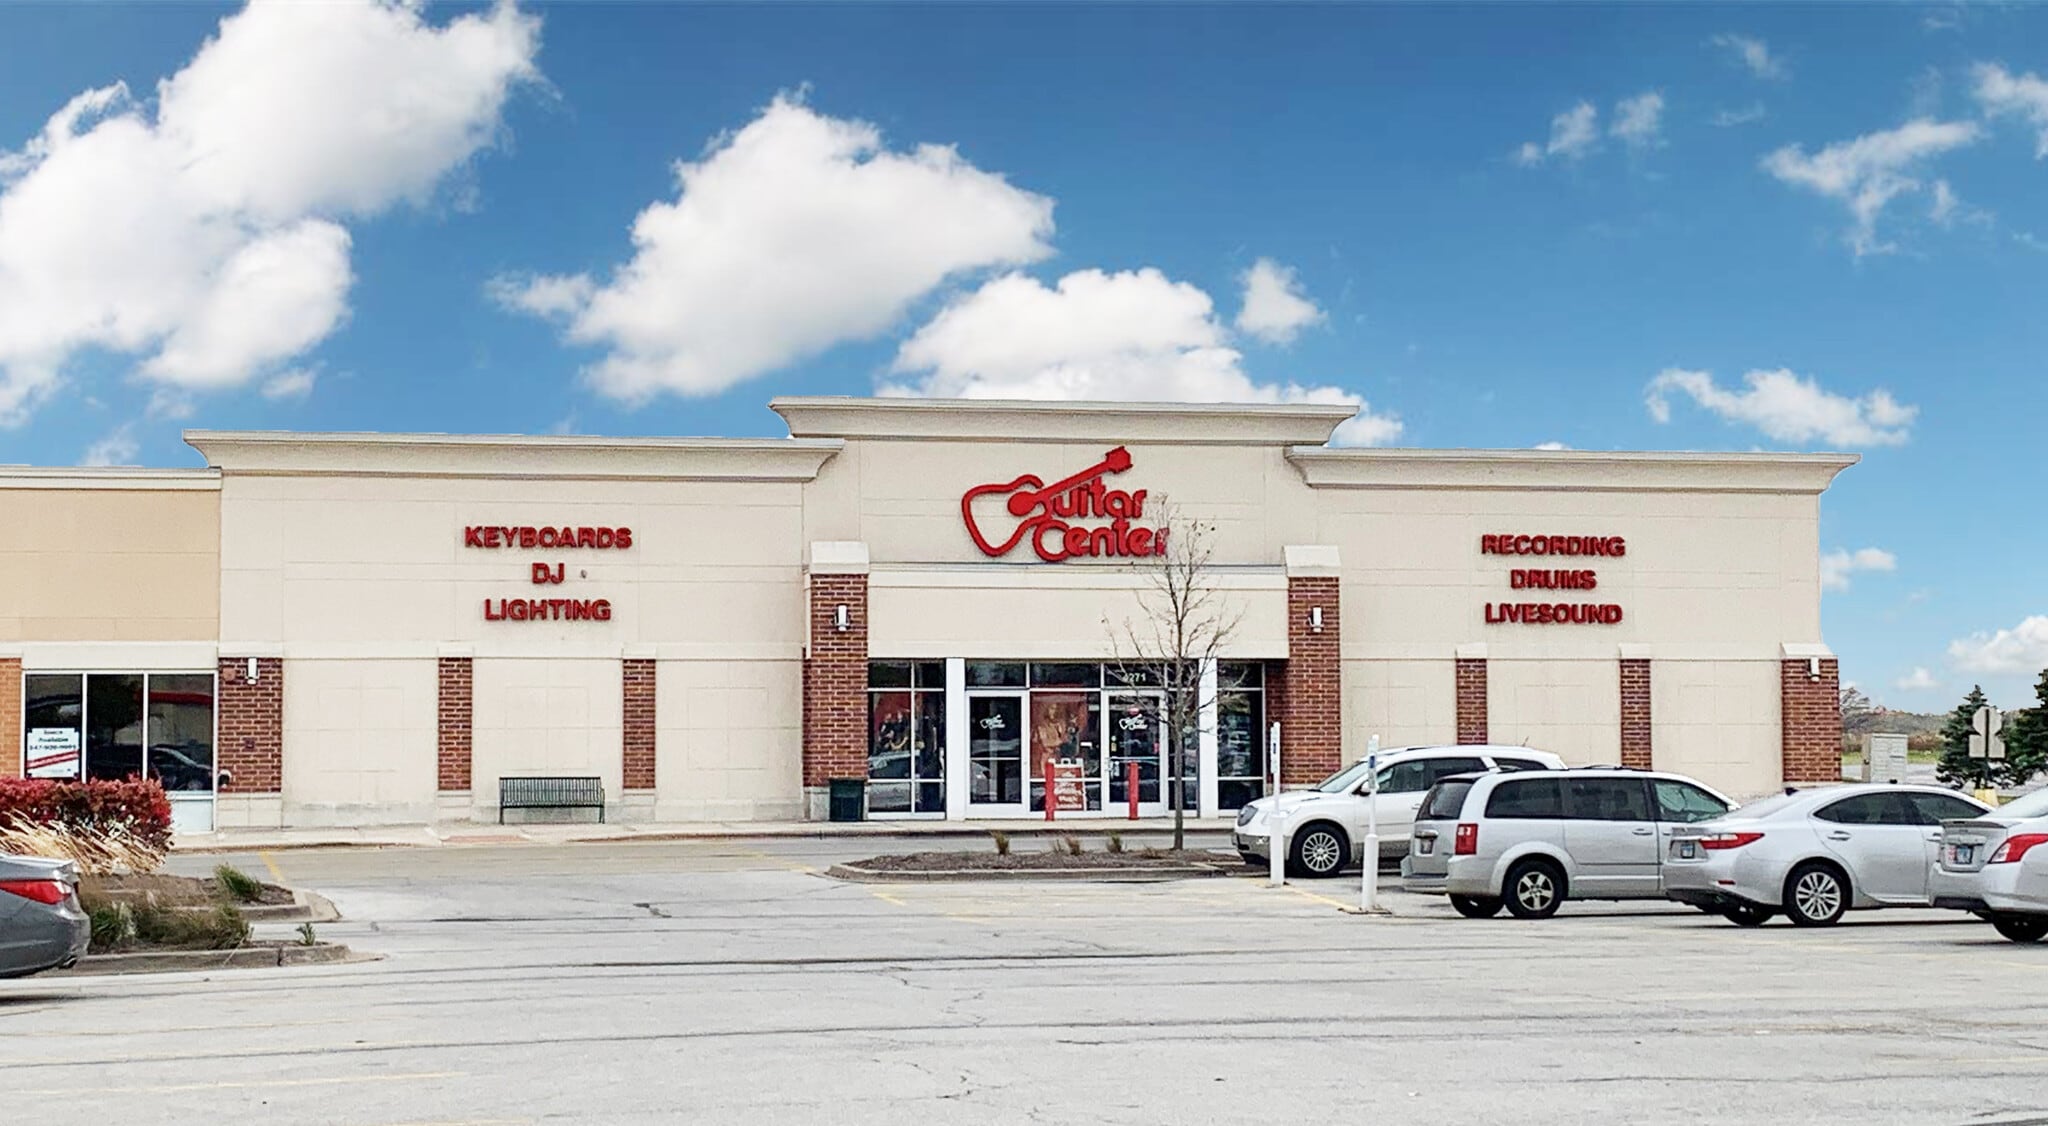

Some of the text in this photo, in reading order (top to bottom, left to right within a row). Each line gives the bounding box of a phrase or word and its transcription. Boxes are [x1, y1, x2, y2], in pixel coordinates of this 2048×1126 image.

[961, 446, 1148, 557] Guitar
[464, 526, 633, 549] KEYBOARDS
[1032, 519, 1170, 562] Center
[1481, 534, 1626, 557] RECORDING
[531, 562, 565, 584] DJ
[1510, 569, 1597, 590] DRUMS
[484, 598, 611, 621] LIGHTING
[1484, 602, 1623, 624] LIVESOUND
